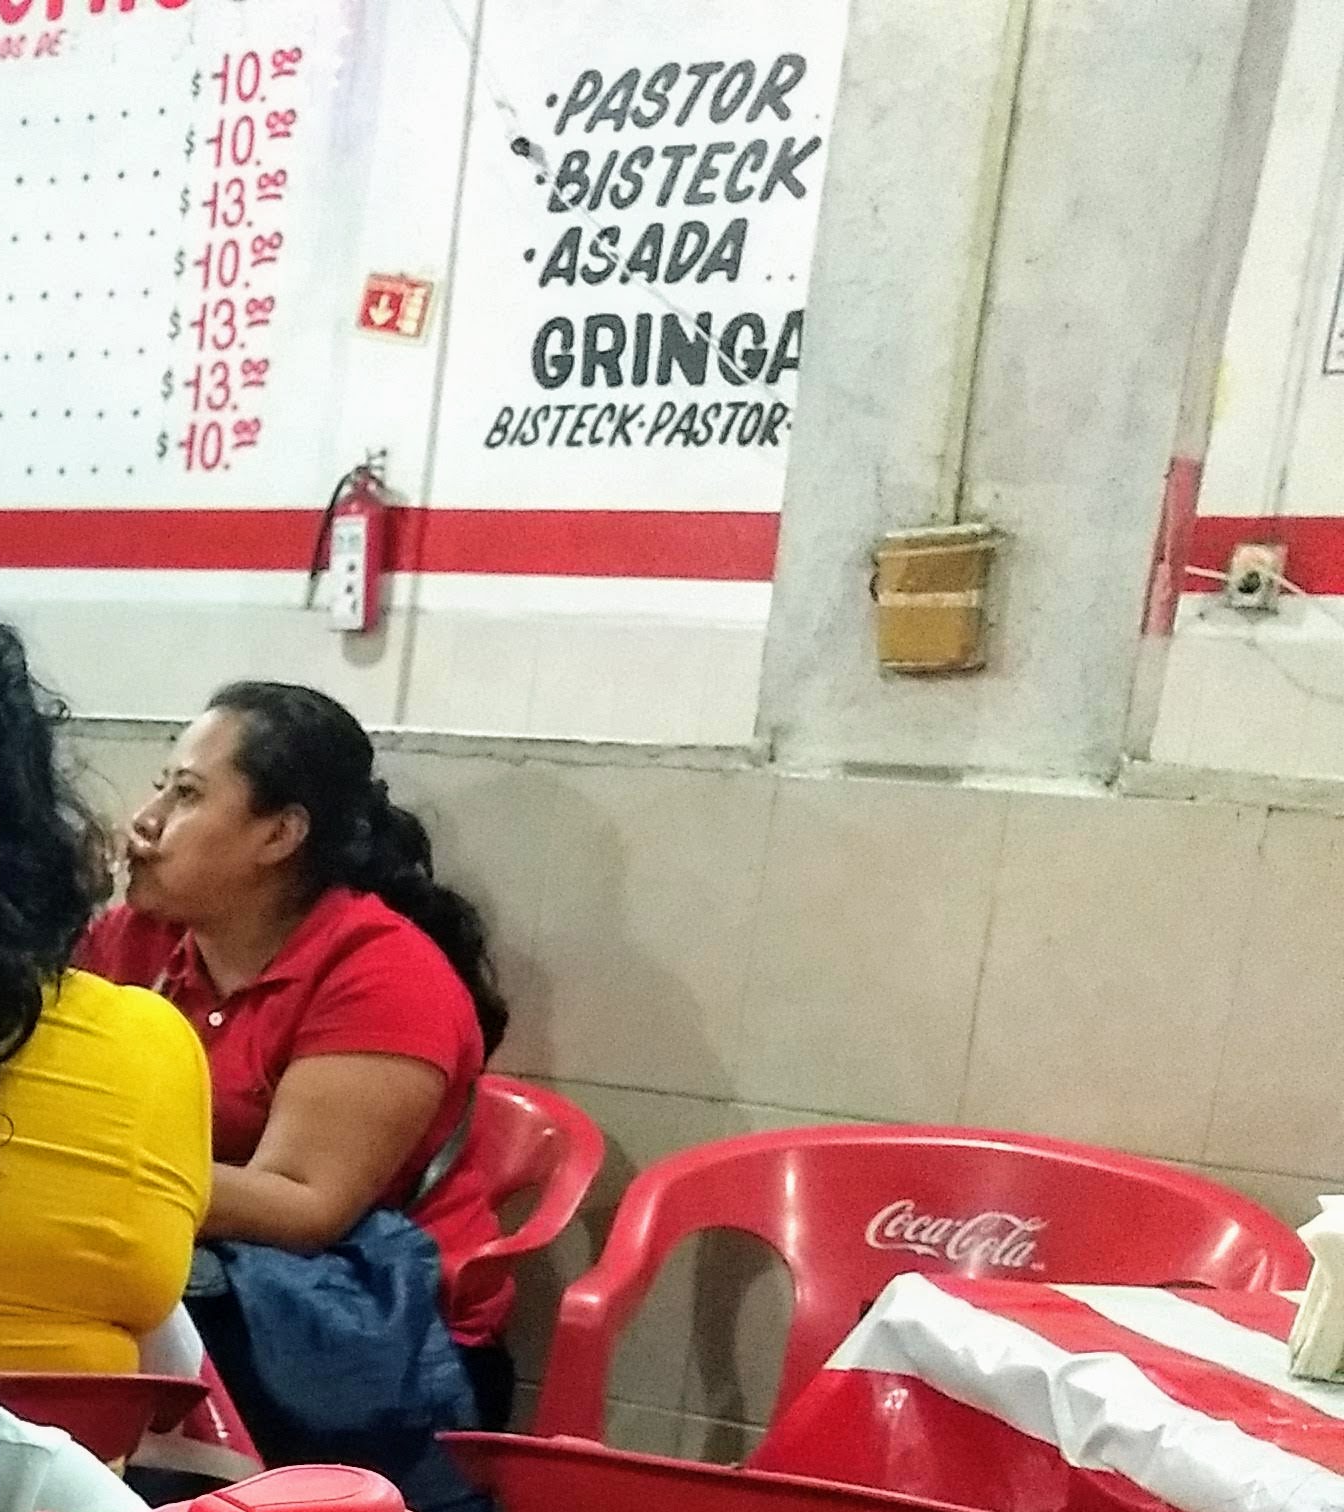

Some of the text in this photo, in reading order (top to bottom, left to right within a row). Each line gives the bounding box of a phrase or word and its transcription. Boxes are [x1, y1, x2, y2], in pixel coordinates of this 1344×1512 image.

[554, 53, 809, 135] PASTOR
[547, 135, 823, 213] BISTECK
[539, 218, 750, 287] ASADA
[865, 1199, 1051, 1267] Coca-Cola
